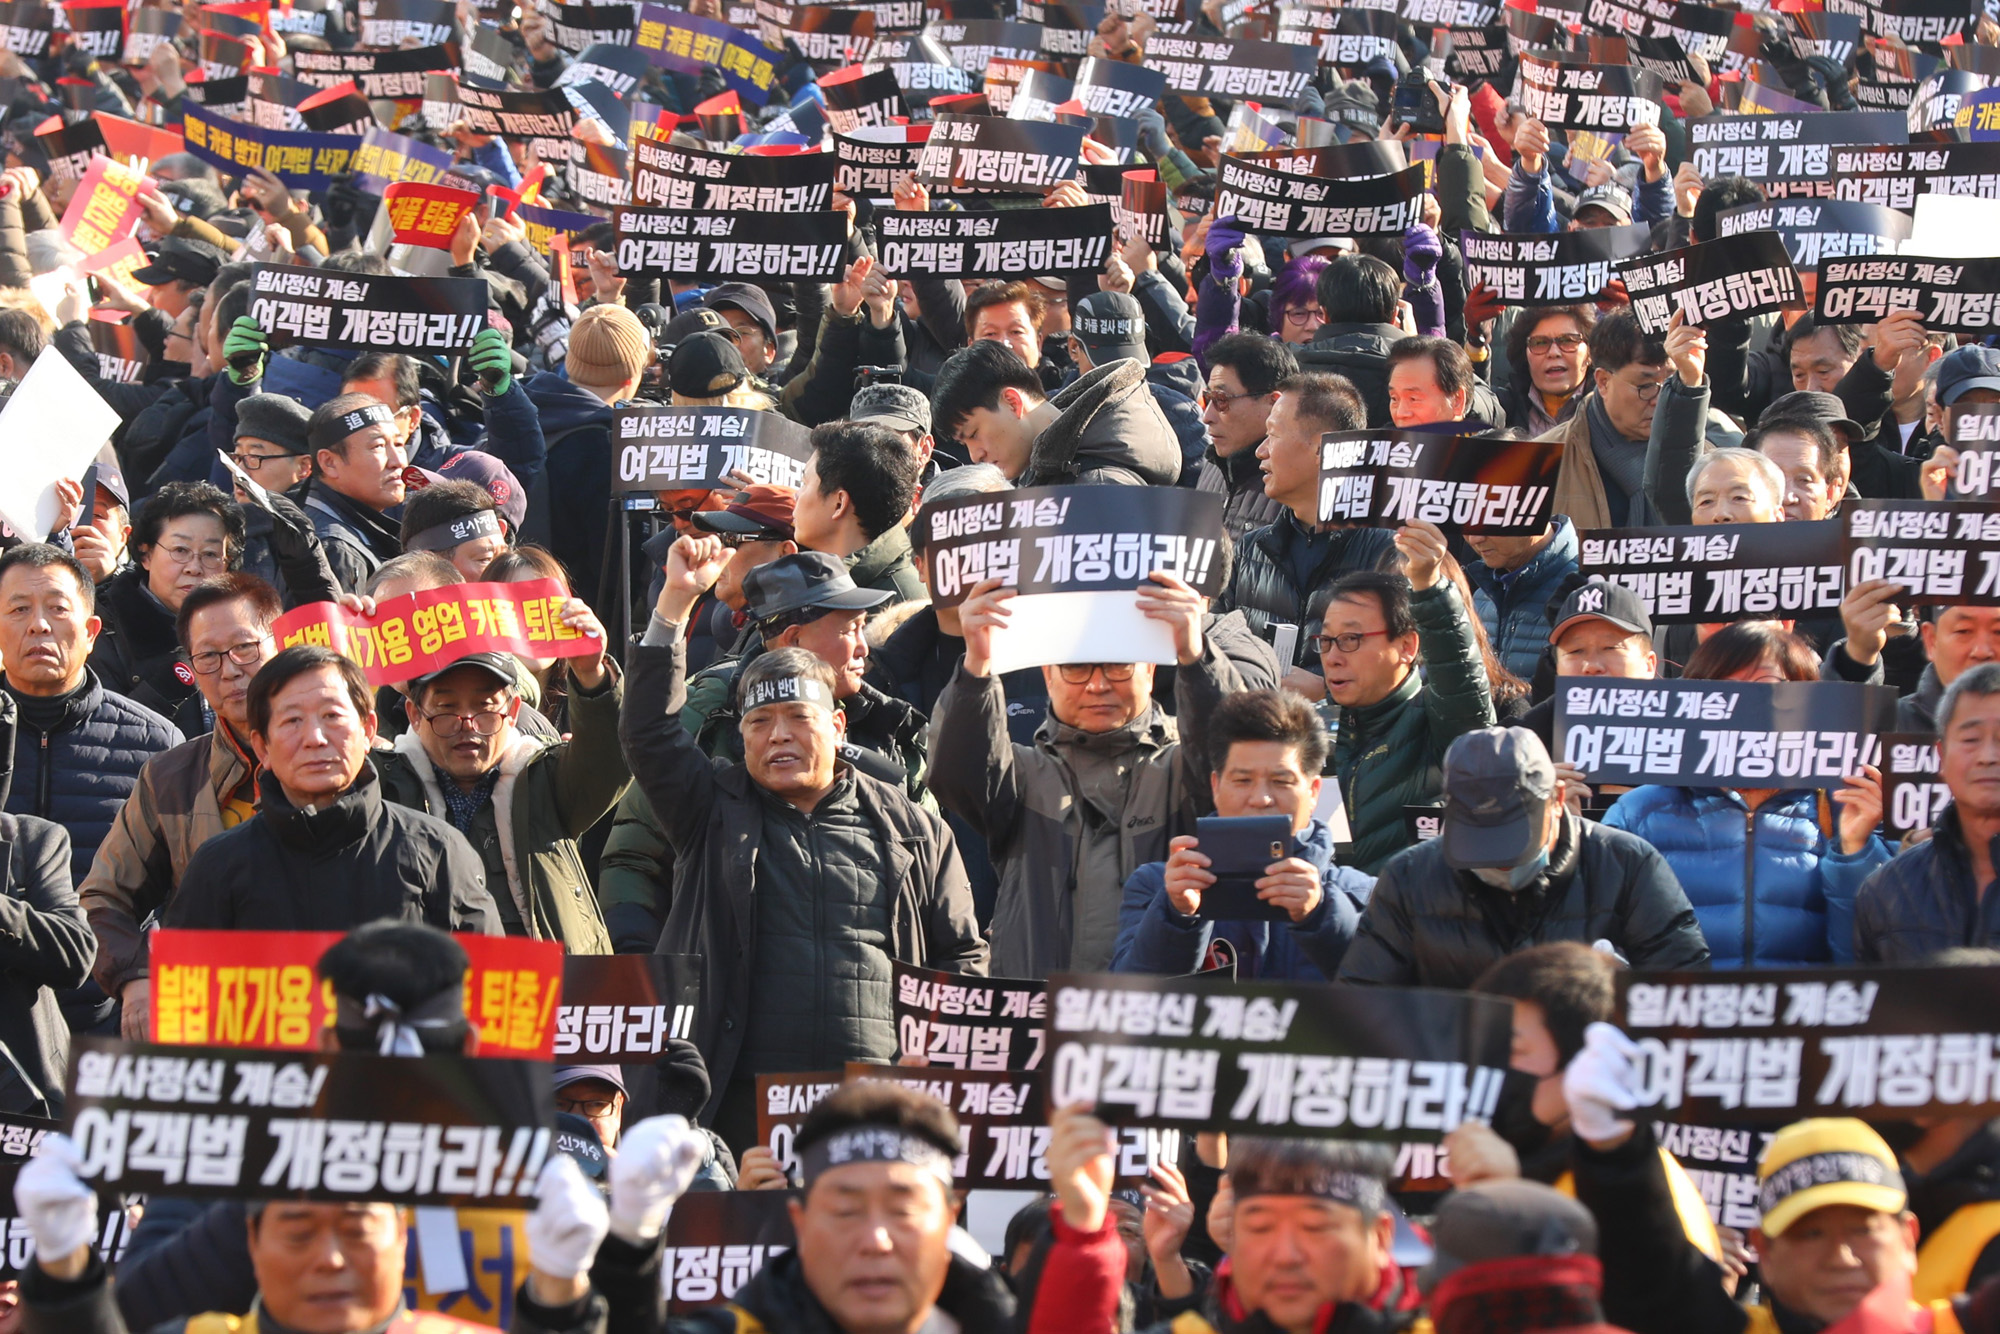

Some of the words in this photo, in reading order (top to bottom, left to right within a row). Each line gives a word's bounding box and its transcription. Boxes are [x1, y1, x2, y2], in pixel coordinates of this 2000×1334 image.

[1308, 12, 1341, 29] 계승!
[636, 18, 667, 50] 불법
[666, 26, 694, 58] 카풀
[692, 33, 724, 65] 방치
[1145, 37, 1198, 59] 열사정신
[1198, 42, 1234, 61] 계승!
[344, 55, 375, 71] 계승!
[1562, 70, 1604, 90] 계승!
[1204, 64, 1312, 99] 개정하라!!
[949, 122, 980, 142] 계승!
[1692, 121, 1757, 144] 열사정신
[1762, 120, 1803, 141] 계승!
[234, 136, 264, 167] 방치
[265, 145, 312, 175] 여객법
[639, 144, 685, 173] 열사정신
[689, 157, 731, 179] 계승!
[838, 142, 901, 165] 열사정신
[956, 149, 1073, 187] 개정하라!!
[1693, 145, 1770, 180] 여객법
[1837, 152, 1903, 173] 열사정신
[1908, 151, 1950, 172] 계승!
[635, 172, 697, 207] 여객법
[704, 182, 829, 212] 개정하라!!
[1222, 163, 1281, 198] 열사정신
[1287, 180, 1330, 202] 계승!
[1837, 177, 1916, 210] 여객법
[416, 197, 473, 236] 퇴출!
[619, 212, 687, 235] 열사정신
[692, 215, 736, 237] 계승!
[882, 215, 950, 237] 열사정신
[955, 216, 999, 237] 계승!
[1217, 190, 1292, 232] 여객법
[1297, 193, 1424, 234] 개정하라!!
[1721, 211, 1774, 236] 열사정신
[1777, 206, 1822, 227] 계승!
[617, 238, 701, 274] 여객법
[707, 241, 843, 276] 개정하라!!
[884, 242, 963, 274] 여객법
[972, 236, 1106, 273] 개정하라!!
[1465, 238, 1513, 262] 열사정신
[1518, 240, 1559, 262] 계승!
[255, 270, 320, 298] 열사정신
[324, 278, 370, 302] 계승!
[1654, 258, 1685, 286] 계승!
[1826, 262, 1908, 282] 열사정신
[1911, 265, 1965, 286] 계승!
[1671, 267, 1796, 326] 개정하라!!
[1823, 286, 1921, 319] 여객법
[251, 297, 332, 341] 여객법
[339, 308, 484, 349] 개정하라!!
[620, 416, 697, 438] 열사정신
[701, 415, 750, 438] 계승!
[619, 445, 710, 483] 여객법
[1321, 441, 1369, 471] 열사정신
[1368, 441, 1425, 469] 계승!
[1319, 474, 1376, 523] 여객법
[1381, 476, 1550, 527] 개정하라!!
[931, 509, 1003, 542] 열사정신
[1009, 497, 1072, 529] 계승!
[1850, 509, 1951, 540] 열사정신
[935, 538, 1022, 597] 여객법
[1032, 532, 1216, 585] 개정하라!!
[1582, 536, 1676, 567] 열사정신
[1682, 534, 1741, 562] 계승!
[1851, 547, 1967, 596] 여객법
[412, 600, 468, 654] 영업
[467, 598, 521, 638] 카풀
[755, 676, 775, 703] 결사
[777, 676, 800, 698] 반대
[1566, 686, 1668, 719] 열사정신
[1673, 692, 1739, 720] 계승!
[1565, 724, 1686, 775] 여객법
[1694, 729, 1882, 780] 개정하라!!
[156, 963, 210, 1044] 불법
[216, 965, 313, 1047] 자가용
[482, 968, 560, 1050] 퇴출!
[899, 974, 994, 1019] 열사정신
[1626, 982, 1776, 1029] 열사정신
[1782, 980, 1880, 1028] 계승!
[1053, 986, 1199, 1038] 열사정신
[1202, 994, 1301, 1043] 계승!
[76, 1050, 224, 1103] 열사정신
[232, 1058, 328, 1107] 계승!
[1051, 1041, 1223, 1121] 여객법
[1230, 1052, 1507, 1133] 개정하라!!
[1634, 1035, 1806, 1111] 여객법
[958, 1081, 1031, 1115] 계승!
[75, 1108, 249, 1187] 여객법
[261, 1118, 552, 1200] 개정하라!!
